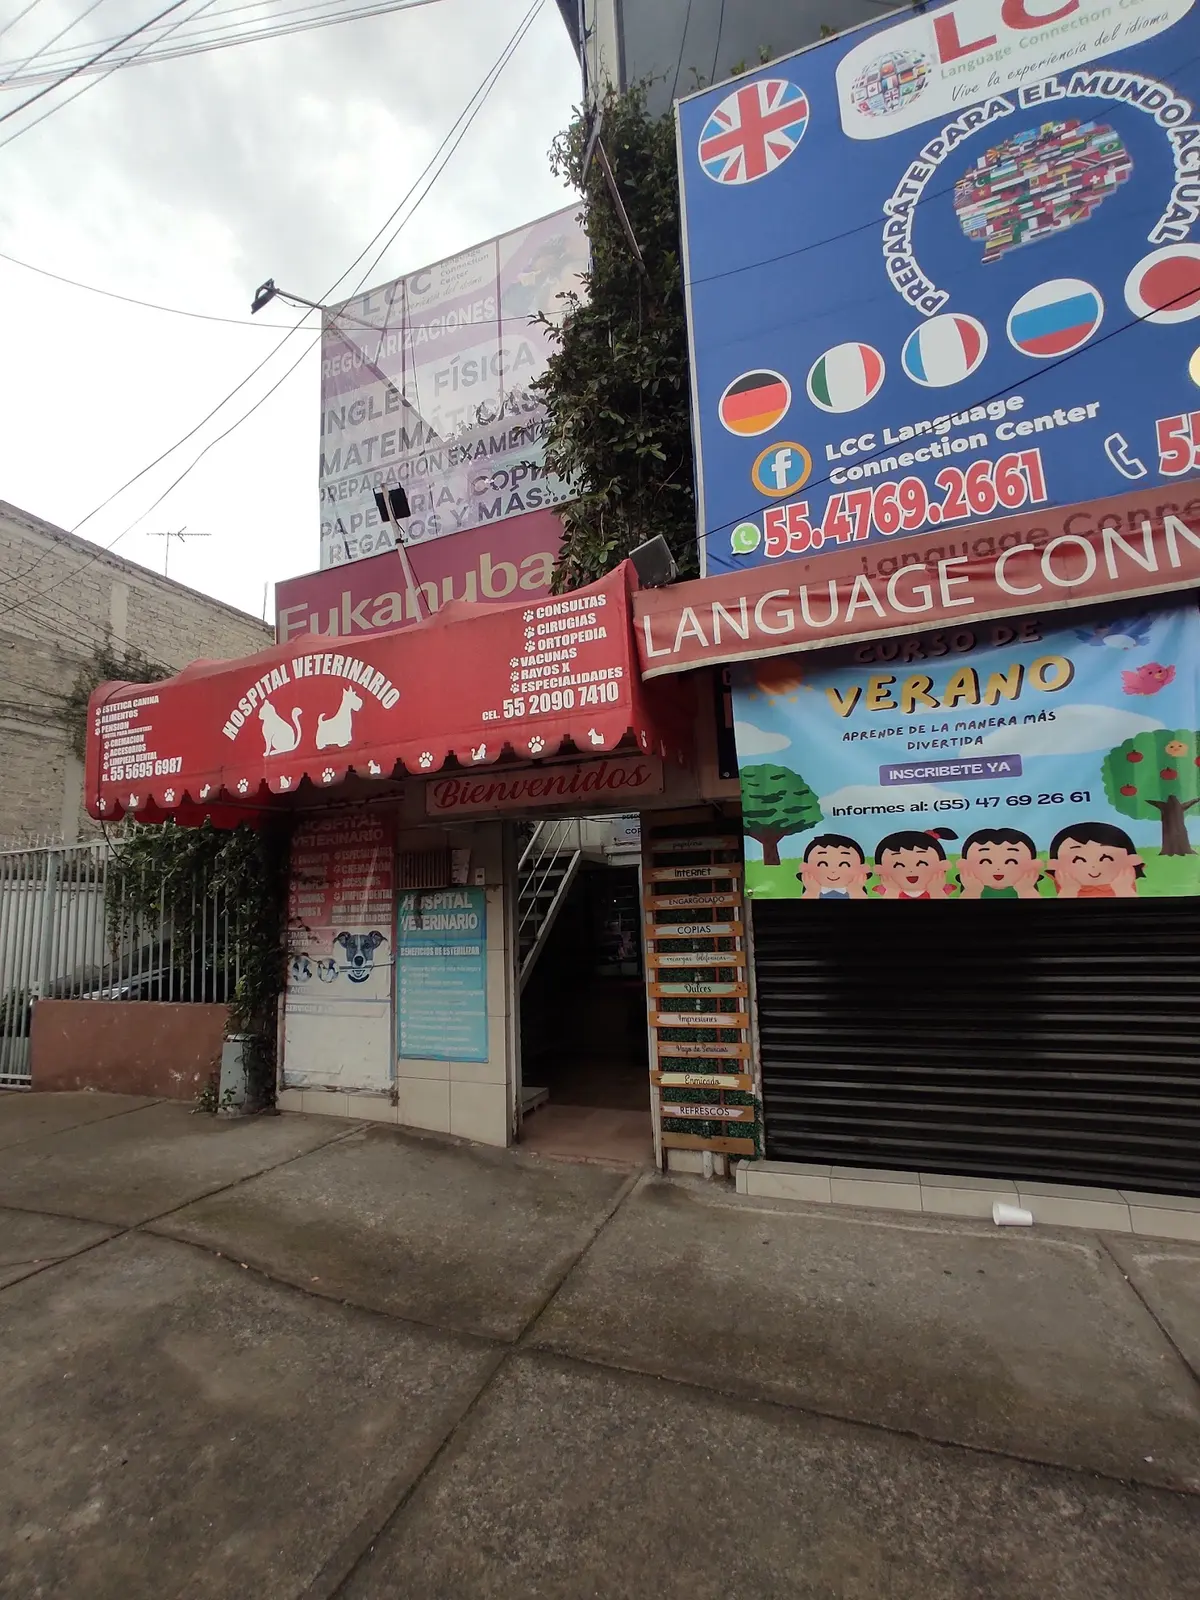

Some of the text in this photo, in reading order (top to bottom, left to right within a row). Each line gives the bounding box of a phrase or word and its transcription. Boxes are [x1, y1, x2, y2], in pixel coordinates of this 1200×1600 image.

[940, 6, 1111, 80] Language Connection
[952, 12, 1168, 101] Vive la experiencia del idioma
[926, 99, 1011, 162] PARA
[1021, 79, 1063, 106] EL
[1069, 74, 1187, 124] MUNDO
[1152, 127, 1200, 241] ACTUAL
[434, 342, 536, 397] FÍSICA
[825, 396, 1024, 461] LCC Language
[829, 401, 1100, 485] Connection Center
[763, 448, 1047, 558] 55.4769.2661
[329, 518, 442, 565] REGAOS
[536, 594, 607, 619] CONSULTAS
[642, 556, 975, 658] LANGUAGE
[537, 612, 597, 636] CIRUGIAS
[538, 626, 607, 651] ORTOPEDIA
[853, 618, 1044, 664] CURSO DE
[520, 647, 578, 668] VACUNAS
[521, 662, 571, 681] RAYOS X
[521, 667, 623, 693] ESPECIALIDADES
[222, 653, 401, 741] HOSPITAL VETERINARIO
[825, 655, 1075, 717] VERANO
[102, 700, 132, 713] ESTETICA
[482, 681, 619, 721] CEL. 55 2090 7410
[101, 709, 138, 723] ALIMENTOS
[842, 710, 1056, 742] APRENDE DE LA MANERA MÁS
[109, 743, 146, 757] ACCESORIOS
[907, 735, 984, 750] DIVERTIDA
[109, 751, 157, 767] LIMPIEZA DENTAL
[110, 765, 124, 781] 55
[125, 761, 153, 780] 5695
[155, 757, 182, 775] 6987
[889, 761, 1011, 780] INSCRIBETE YA
[433, 761, 651, 809] Bienvenidos
[832, 791, 1091, 817] Informes al: (55) 47 69 26 61
[669, 896, 725, 906] ENGARGOLADO
[677, 925, 711, 935] COPIAS
[684, 983, 712, 993] Dulces
[678, 1014, 717, 1026] Impresiones
[680, 1107, 730, 1116] REFRESCOS
